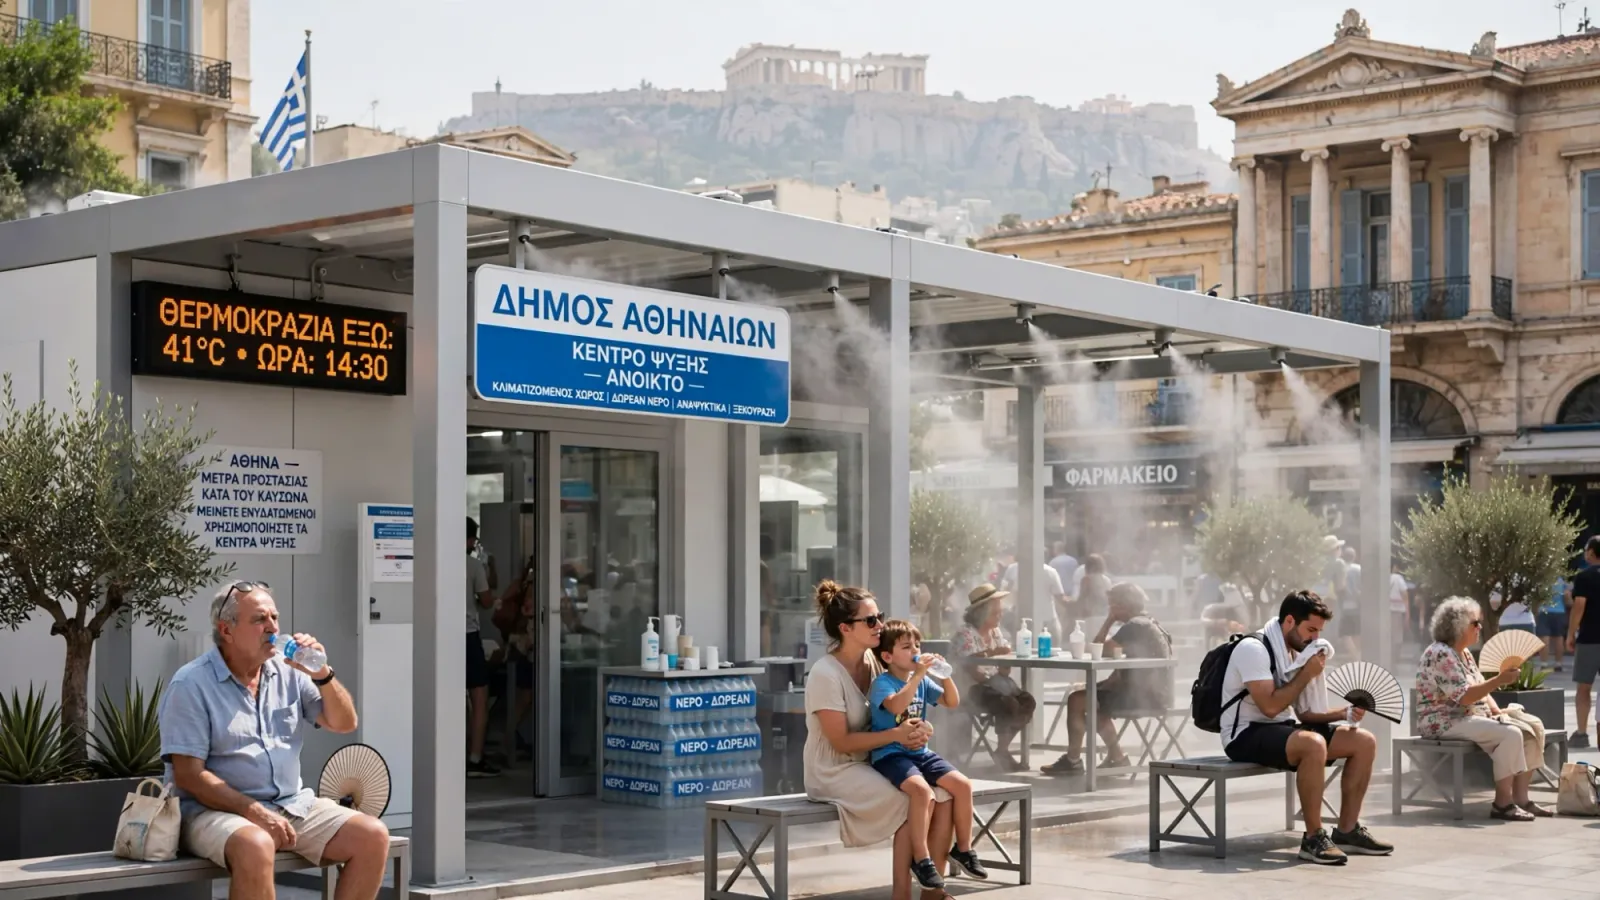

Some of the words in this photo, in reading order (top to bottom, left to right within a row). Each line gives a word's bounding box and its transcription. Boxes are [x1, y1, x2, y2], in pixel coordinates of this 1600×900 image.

[160, 297, 335, 343] ΘΕΡΜΟΚΡΑΖΙΑ
[343, 318, 393, 349] ΕΞΩ:
[492, 283, 614, 329] ΔΗΜΟΣ
[622, 302, 776, 349] ΑΘΗΝΑΙΩΝ
[163, 333, 226, 366] 41°C
[257, 343, 314, 375] ΩΡΑ:
[326, 349, 388, 381] 14:30
[572, 341, 646, 368] ΚΕΝΤΡΟ
[651, 350, 709, 375] ΨΥΞΗΣ
[606, 368, 684, 393] ΑΝΟΙΚΤΟ
[492, 381, 573, 399] ΚΛΙΜΑΤΙΖΟΜΕΝΟΣ
[575, 388, 605, 402] ΧΩΡΟΣ
[611, 392, 646, 406] ΔΩΡΕΑΝ
[647, 397, 670, 408] ΝΕΡΟ
[676, 399, 727, 413] ΑΝΑΨΥΚΤΙΚΑ
[229, 454, 280, 470] ΑΘΗΝΑ
[201, 472, 240, 485] ΜΕΤΡΑ
[242, 474, 309, 488] ΠΡΟΣΤΑΣΙΑΣ
[1065, 464, 1178, 487] ΦΑΡΜΑΚΕΙΟ
[202, 488, 230, 501] ΚΑΤΑ
[233, 489, 255, 502] ΤΟΥ
[257, 490, 309, 504] ΚΑΥΣΩΝΑ
[196, 505, 240, 518] ΜΕΙΝΕΤΕ
[241, 507, 317, 520] ΕΝΥΔΑΤΩΜΕΝΟΙ
[204, 520, 294, 534] ΧΡΗΣΙΜΟΠΟΙΗΣΤΕ
[295, 523, 309, 535] ΤΑ
[215, 536, 258, 549] ΚΕΝΤΡΑ
[260, 537, 297, 549] ΨΥΞΗΣ
[609, 694, 628, 705] ΝΕΡΟ
[631, 696, 659, 708] ΔΩΡΕΑΝ
[675, 696, 703, 709] ΝΕΡΟ
[711, 693, 751, 707] ΔΩΡΕΑΝ
[606, 737, 626, 749] ΝΕΡΟ
[630, 739, 660, 752] ΔΩΡΕΑΝ
[680, 741, 709, 754] ΝΕΡΟ
[716, 736, 757, 751] ΔΩΡΕΑΝ
[605, 777, 625, 789] ΝΕΡΟ
[629, 780, 659, 793] ΔΩΡΕΑΝ
[678, 782, 704, 795] ΝΕΡΟ
[711, 778, 752, 792] ΔΩΡΕΑΝ
